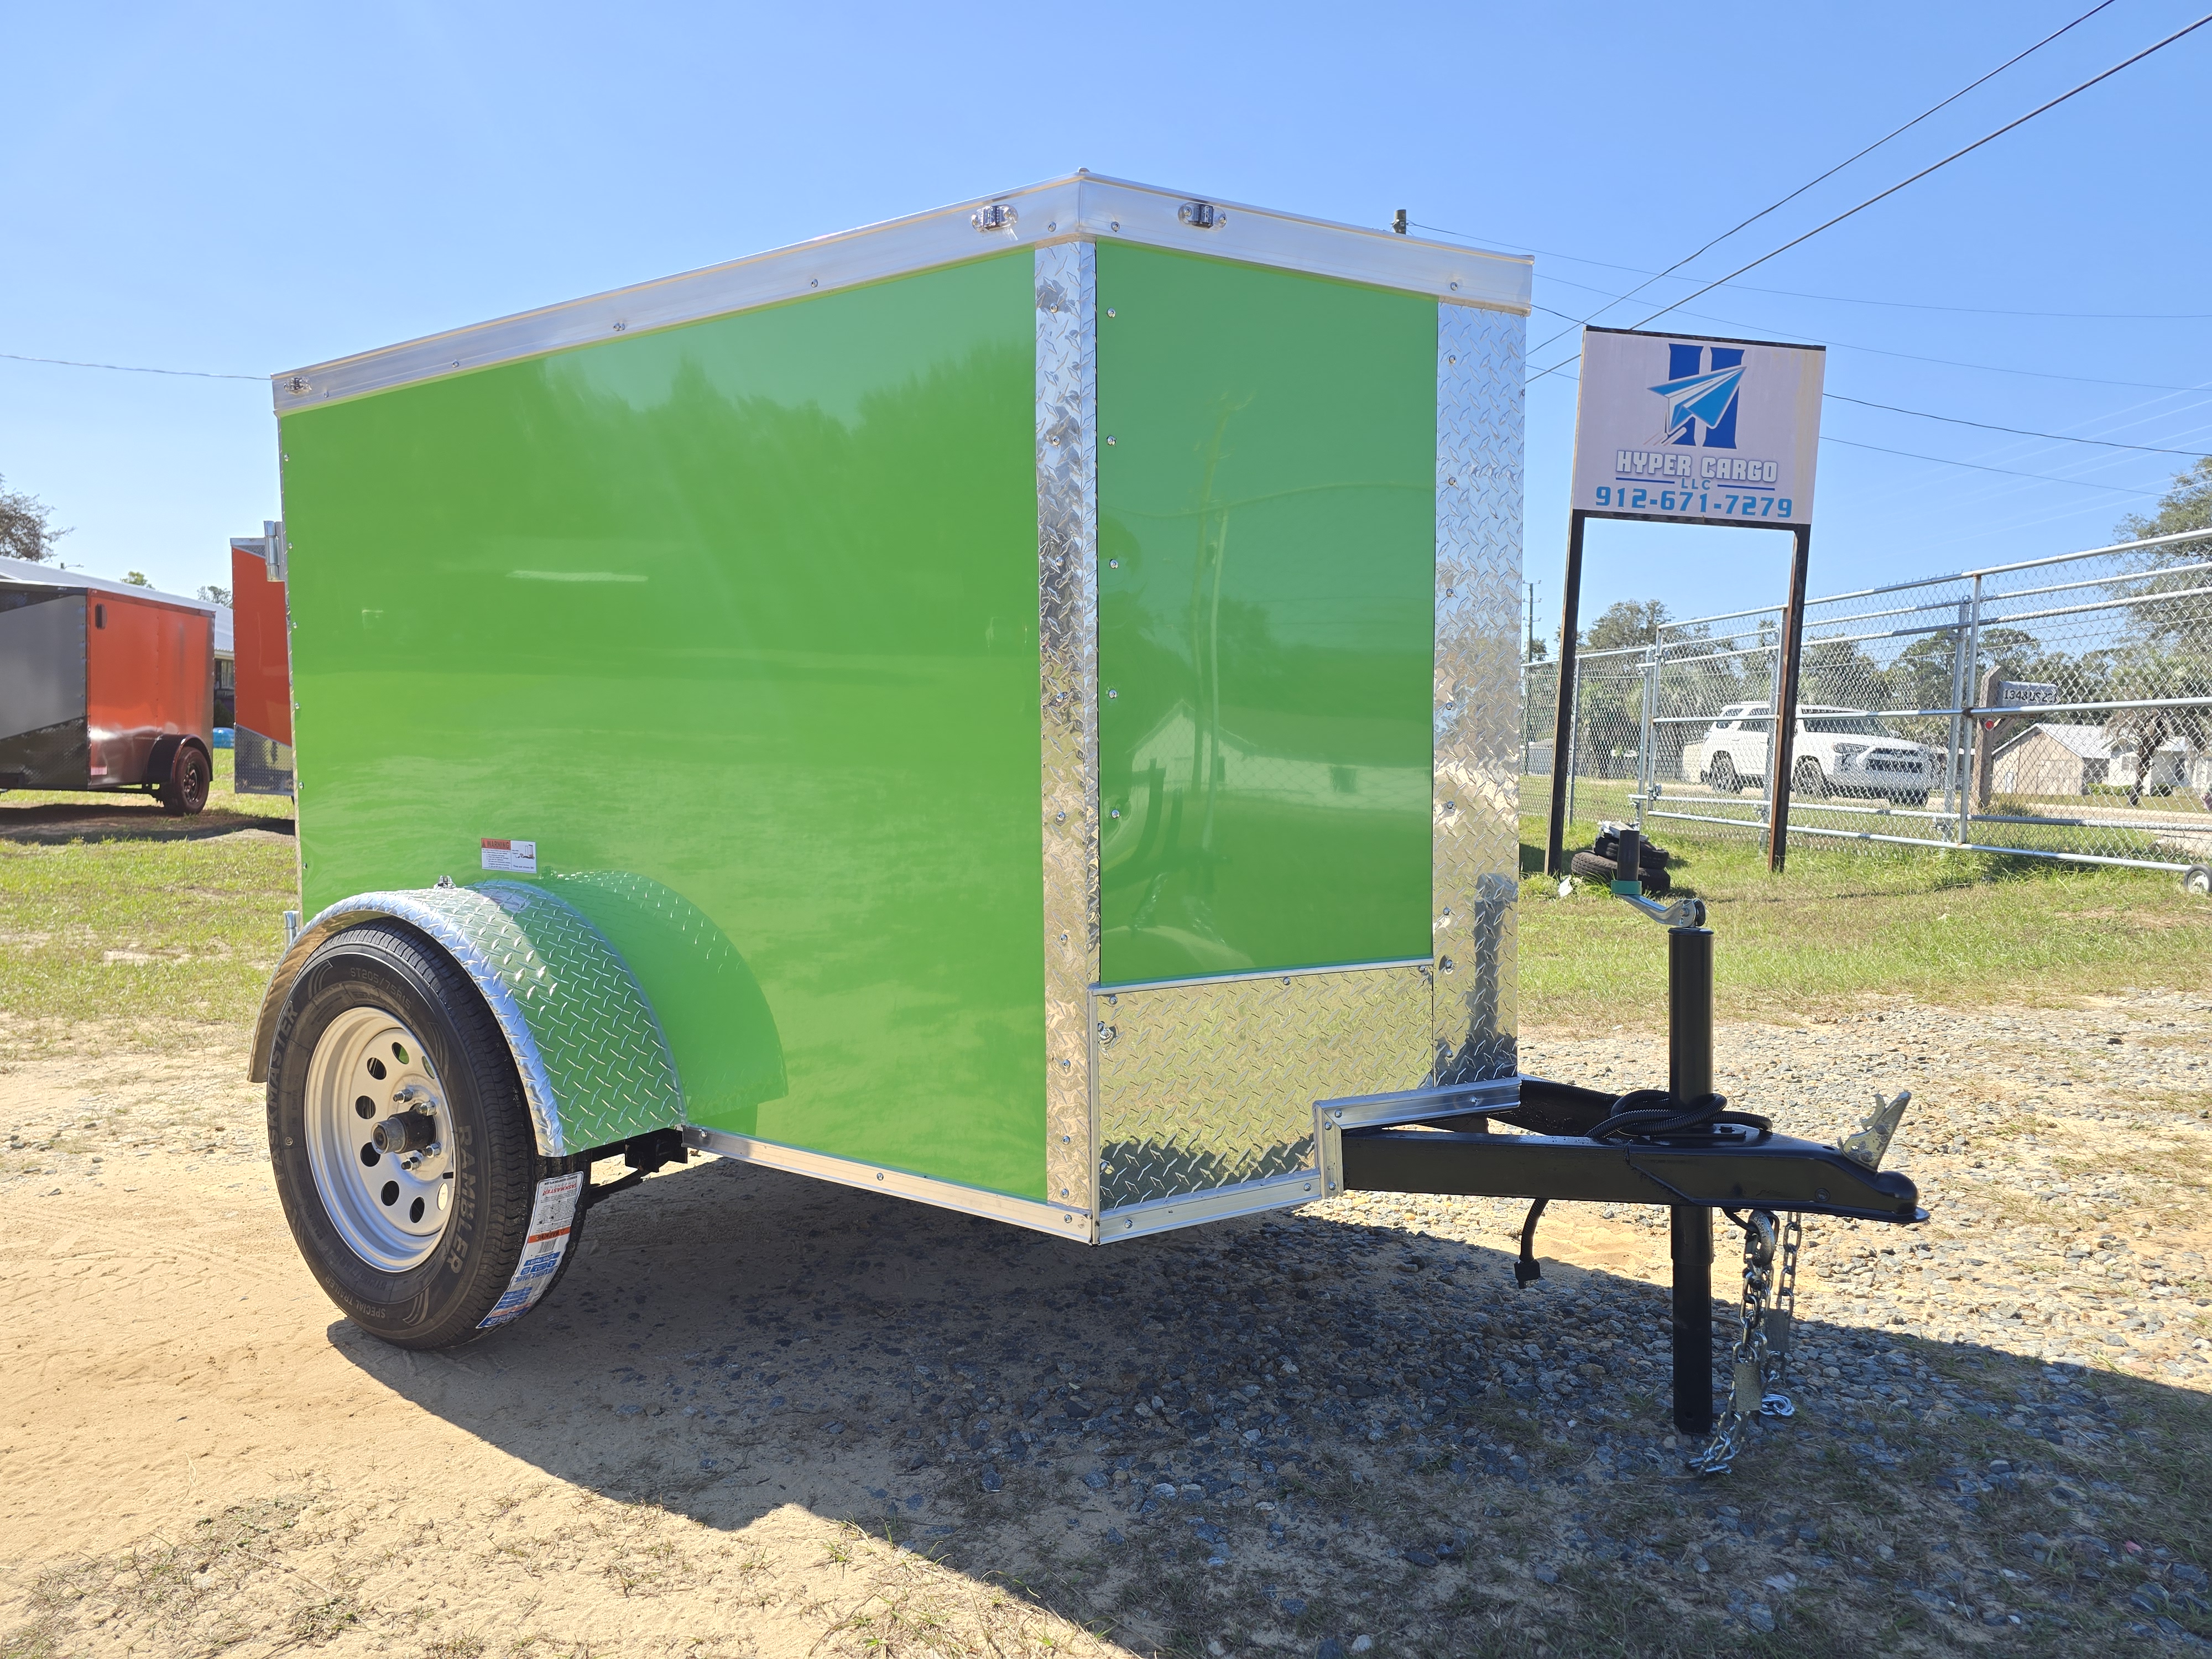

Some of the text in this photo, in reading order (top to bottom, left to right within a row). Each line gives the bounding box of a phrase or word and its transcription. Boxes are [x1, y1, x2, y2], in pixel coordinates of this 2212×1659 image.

[1616, 451, 1778, 483] HYPER CARGO
[1681, 478, 1711, 491] LLC
[1595, 486, 1793, 518] 912-671-7279
[2004, 689, 2028, 700] 1348
[487, 840, 509, 849] WARNING
[350, 967, 412, 1010] ST205/75R15
[268, 1000, 298, 1187] TASKMASTER
[447, 1125, 476, 1274] RAMBLER
[542, 1183, 577, 1196] TASKMASTER
[537, 1230, 559, 1241] WARNING
[325, 1274, 386, 1318] SPECIAL TRAILER
